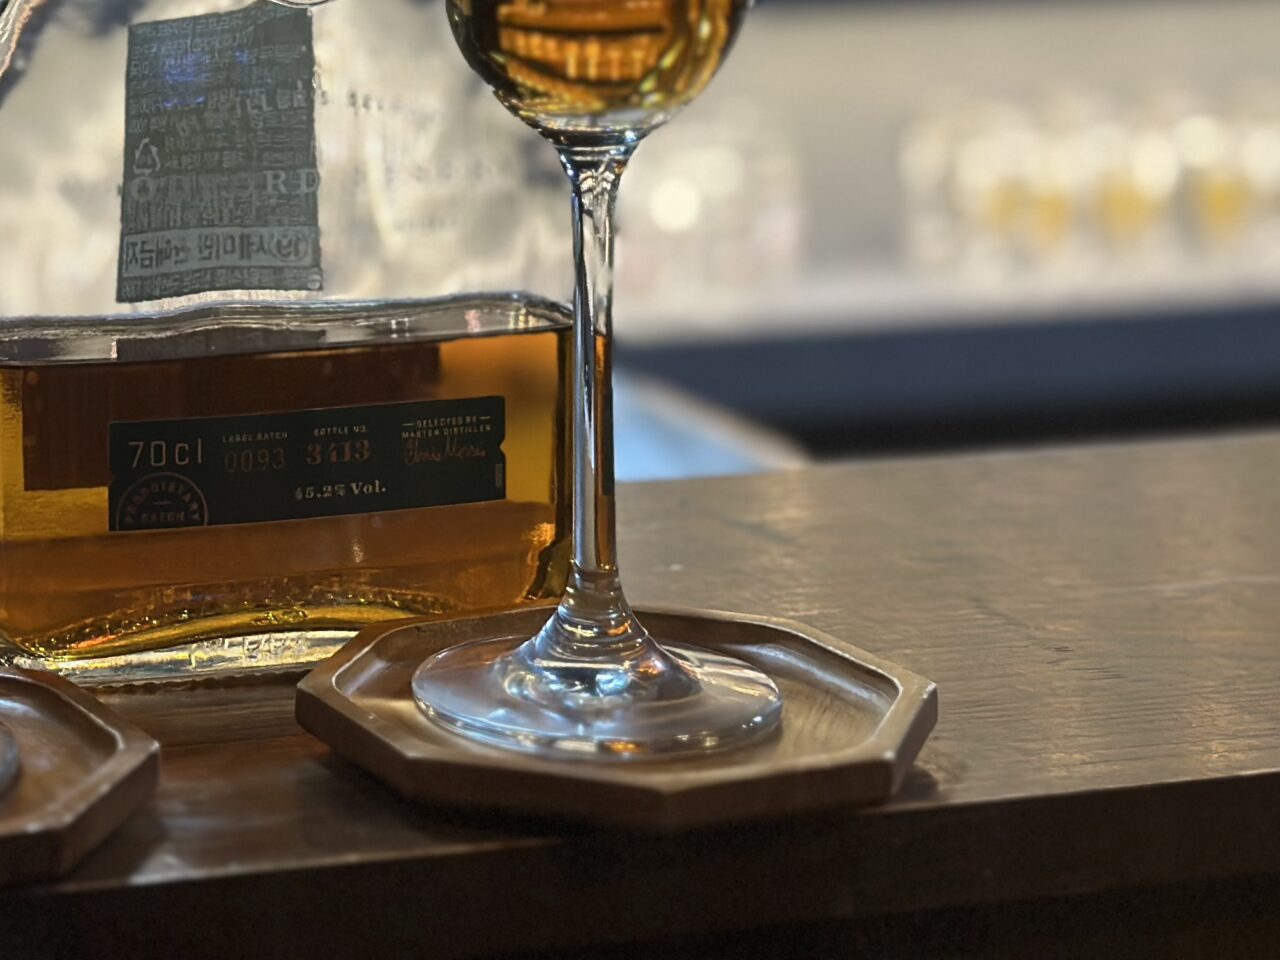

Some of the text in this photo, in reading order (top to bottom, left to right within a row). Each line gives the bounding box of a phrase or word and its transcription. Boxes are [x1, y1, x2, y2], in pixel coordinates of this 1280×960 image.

[416, 417, 462, 429] SELECTED
[313, 426, 349, 437] BOTTLE
[401, 425, 491, 440] MASTER DISTILLER
[128, 437, 203, 470] 70cl
[224, 447, 286, 473] 0093
[350, 479, 387, 495] Vol.
[140, 510, 185, 523] BATCH
